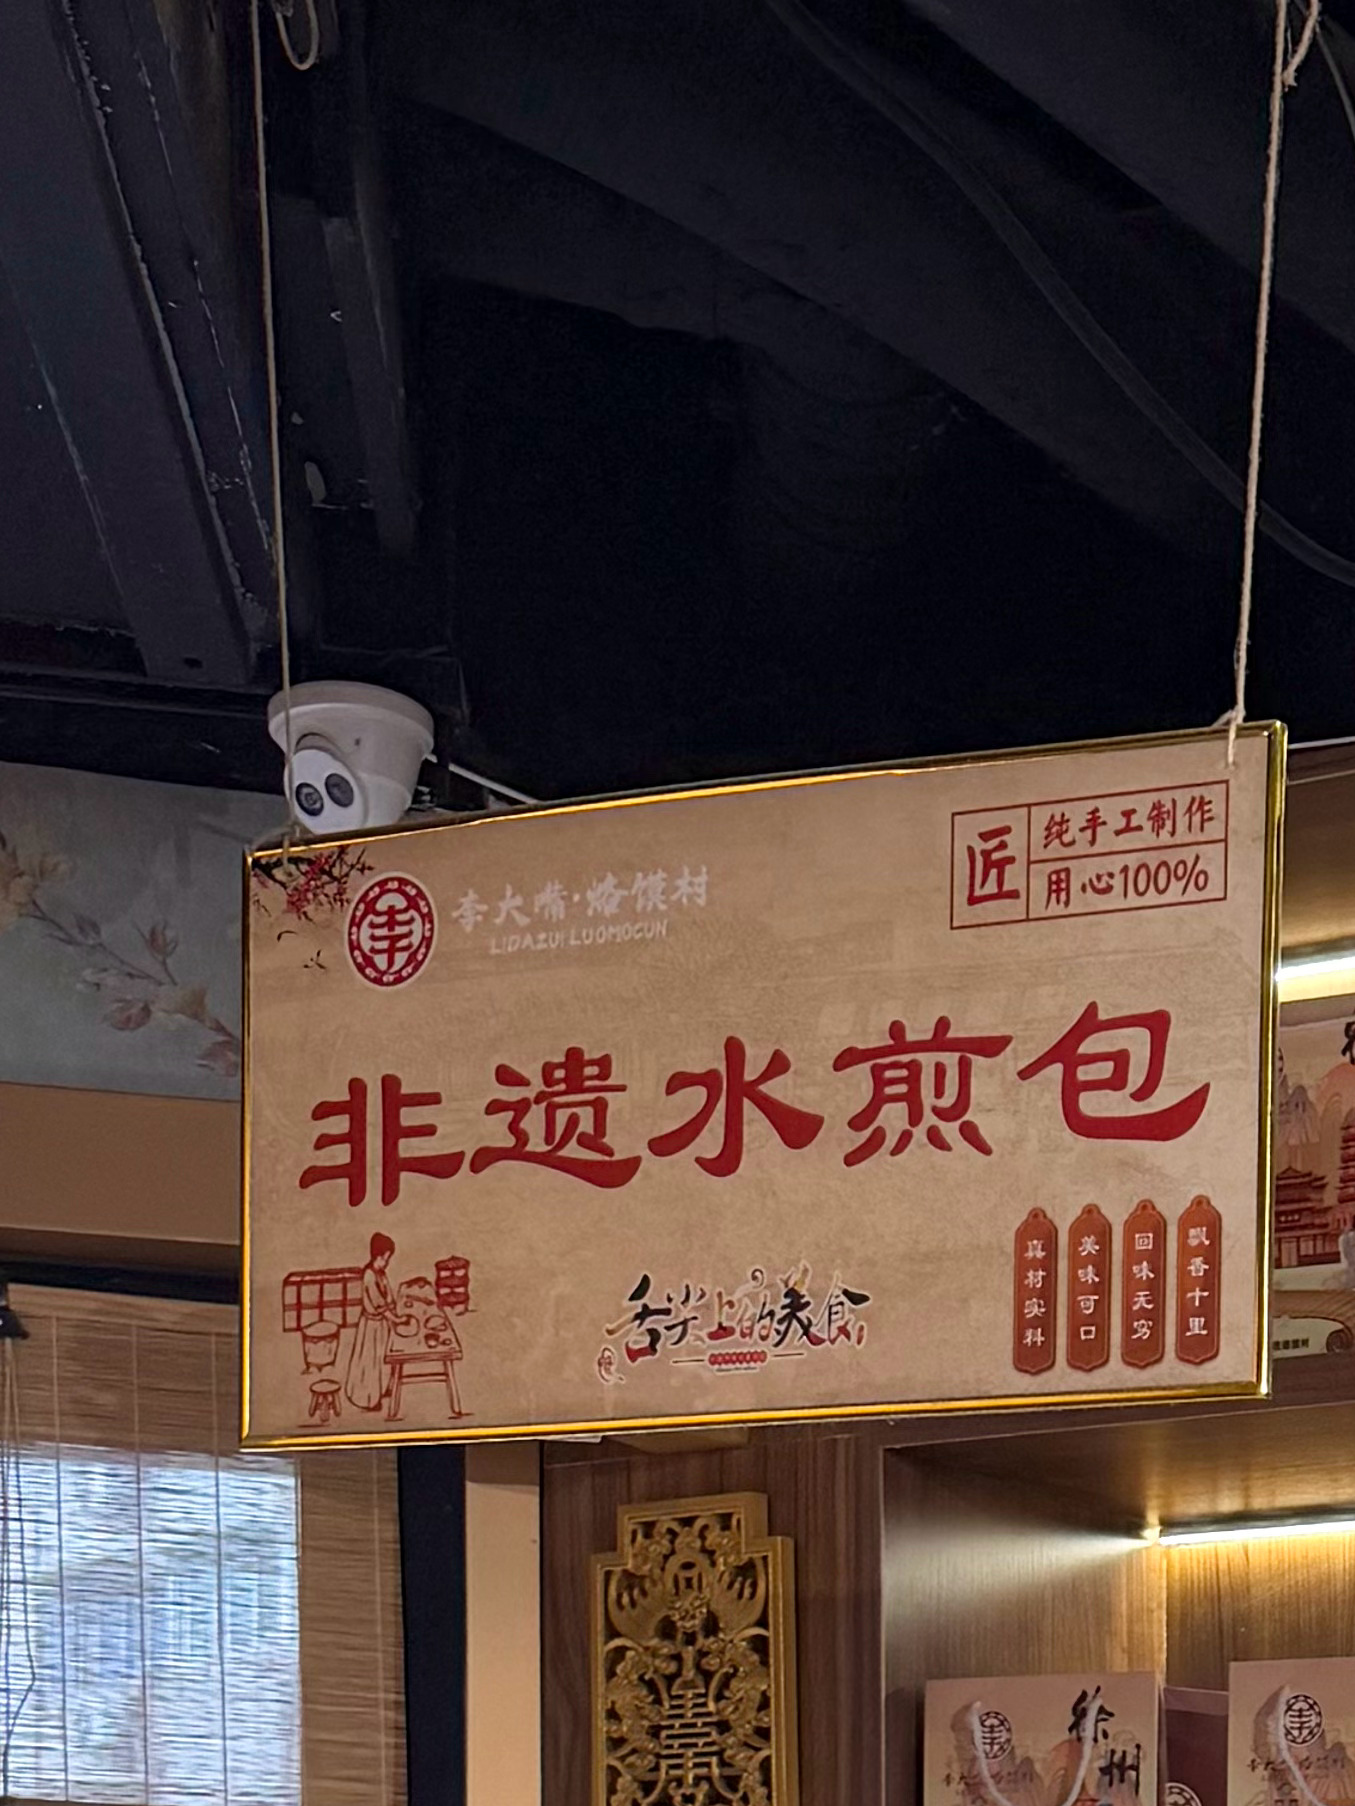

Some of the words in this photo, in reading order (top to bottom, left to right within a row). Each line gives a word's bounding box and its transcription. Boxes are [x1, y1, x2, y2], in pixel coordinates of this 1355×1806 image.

[966, 824, 1021, 907] 匠
[1042, 794, 1216, 850] 纯手工制作
[1044, 852, 1210, 911] 用心100%
[299, 1000, 1211, 1206] 非遗水煎包
[1022, 1239, 1047, 1347] 真材实料
[1076, 1234, 1100, 1341] 美味可口
[1130, 1232, 1155, 1340] 回味无穷
[1184, 1226, 1211, 1337] 飘香十里
